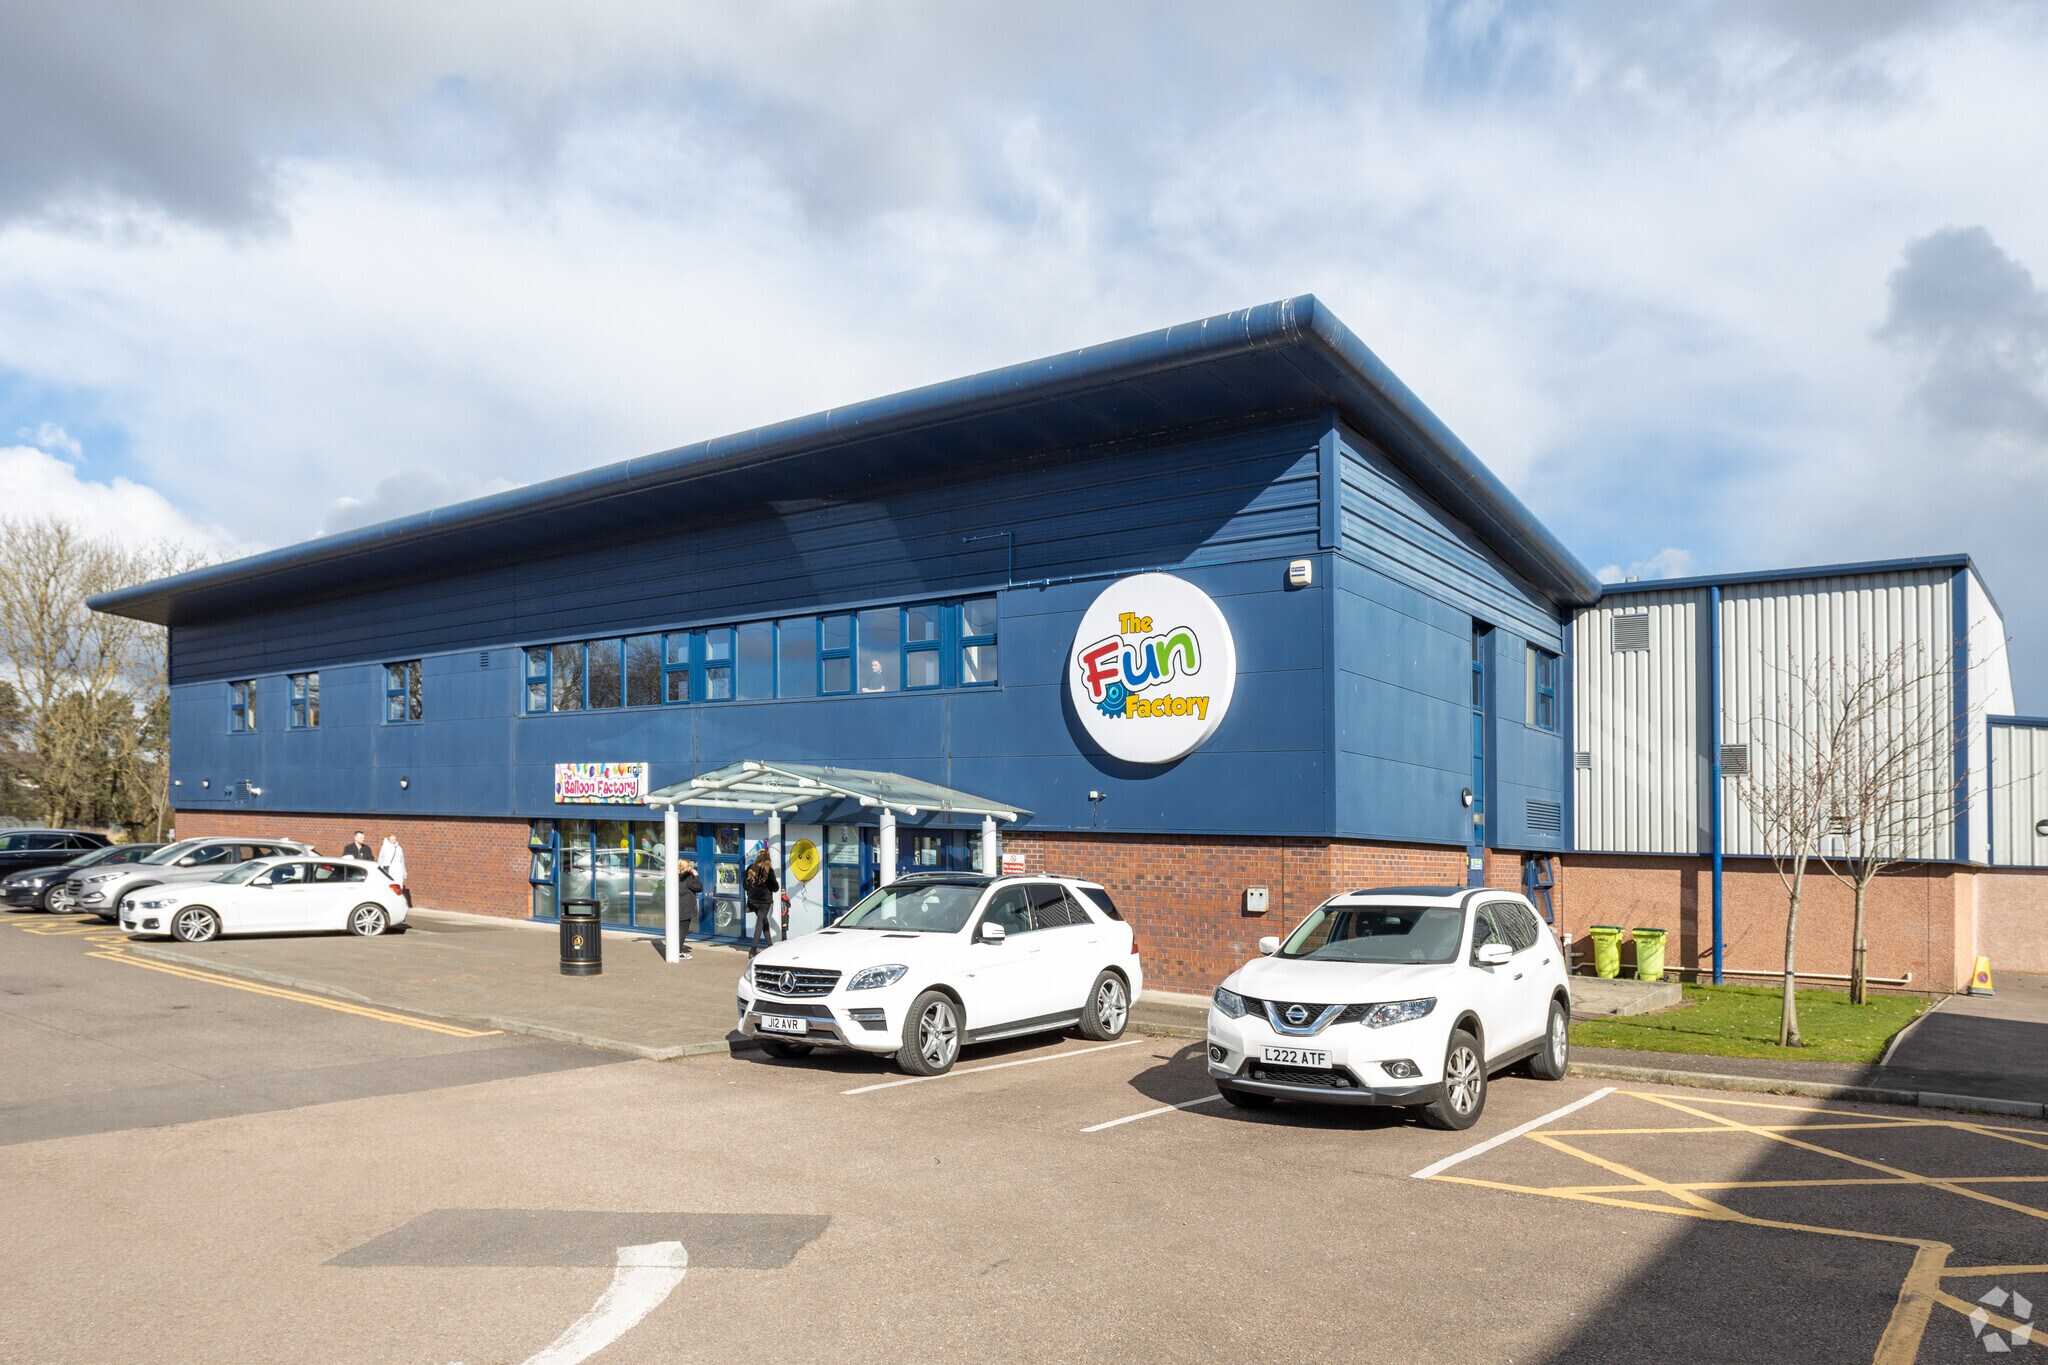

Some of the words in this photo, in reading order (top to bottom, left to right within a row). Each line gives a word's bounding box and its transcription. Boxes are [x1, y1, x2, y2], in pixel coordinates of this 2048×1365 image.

[1119, 612, 1153, 634] The
[1082, 632, 1196, 698] Fun
[1126, 694, 1210, 720] Factory
[564, 780, 595, 794] Balloon
[598, 780, 636, 796] Factory
[781, 1019, 799, 1030] AVR
[1265, 1048, 1297, 1063] L222
[1301, 1052, 1326, 1065] ATF
